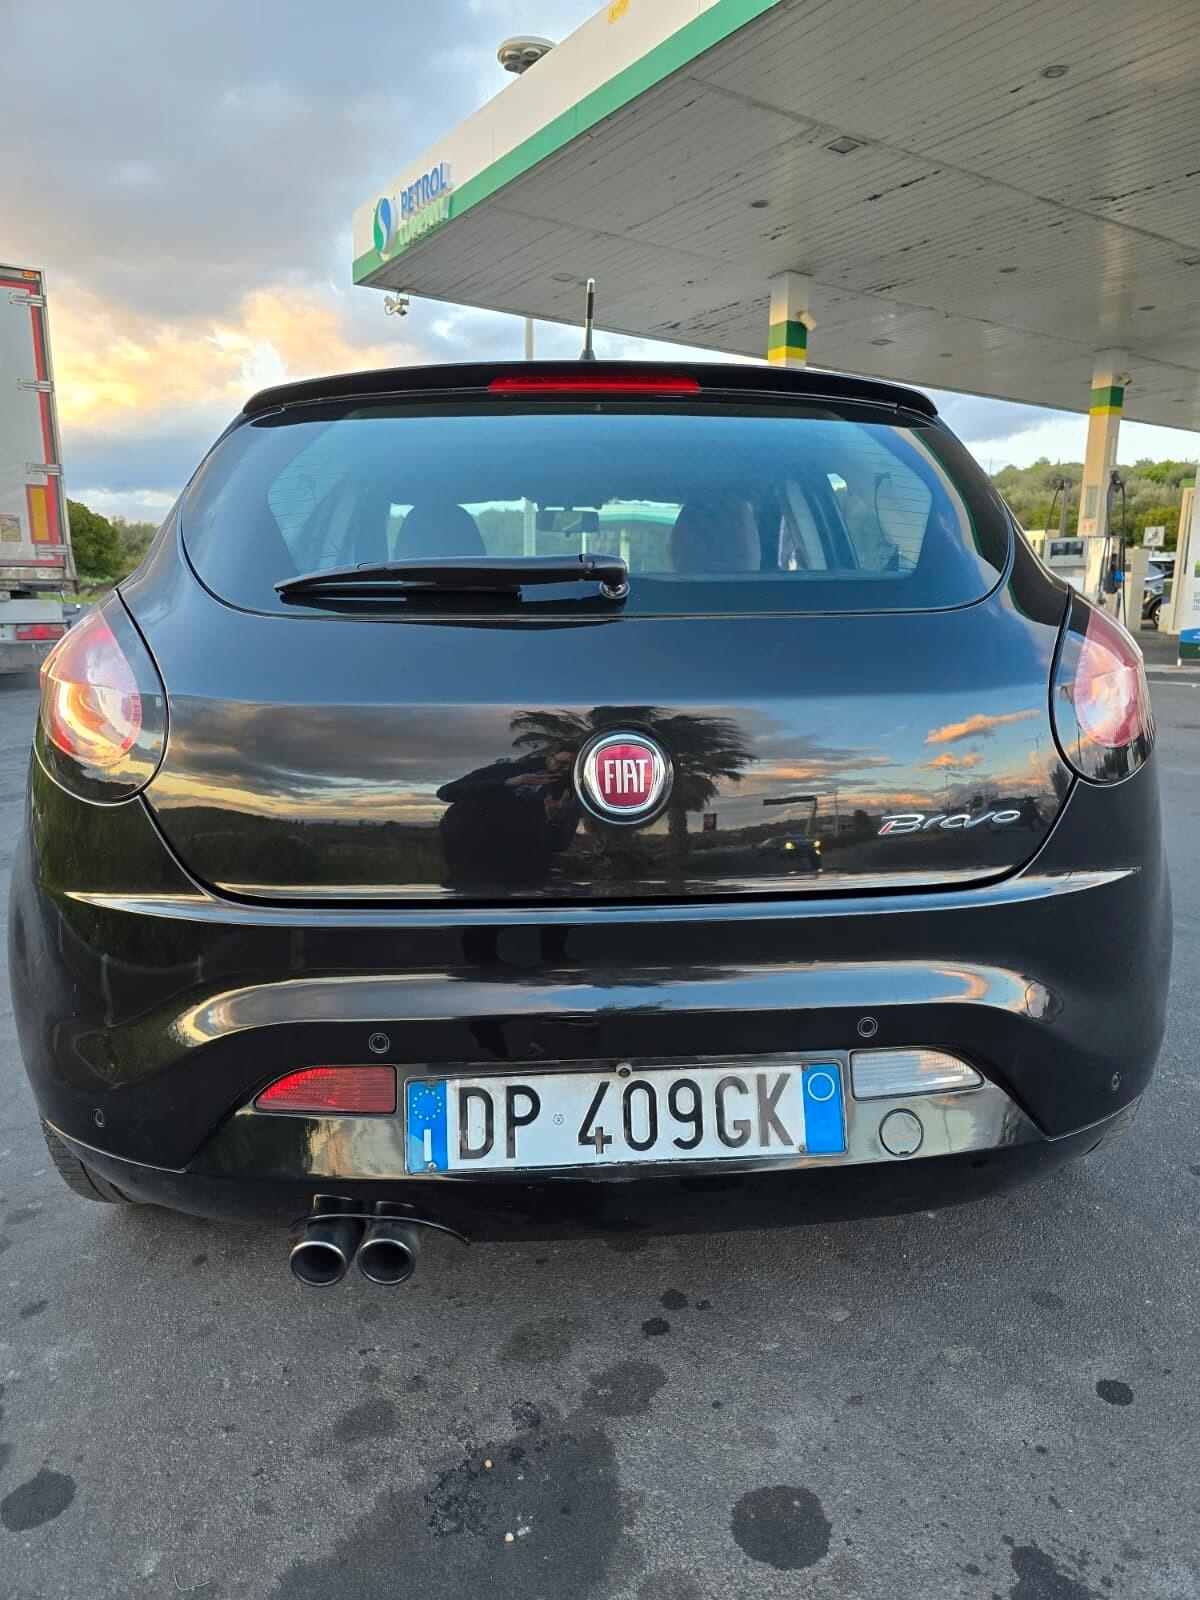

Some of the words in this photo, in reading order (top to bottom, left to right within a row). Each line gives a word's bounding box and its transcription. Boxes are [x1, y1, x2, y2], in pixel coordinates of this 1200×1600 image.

[400, 163, 448, 219] PETROL
[604, 759, 648, 794] FIAT
[878, 809, 1021, 835] Bravo
[458, 1084, 541, 1160] DP
[577, 1072, 794, 1155] 409GK
